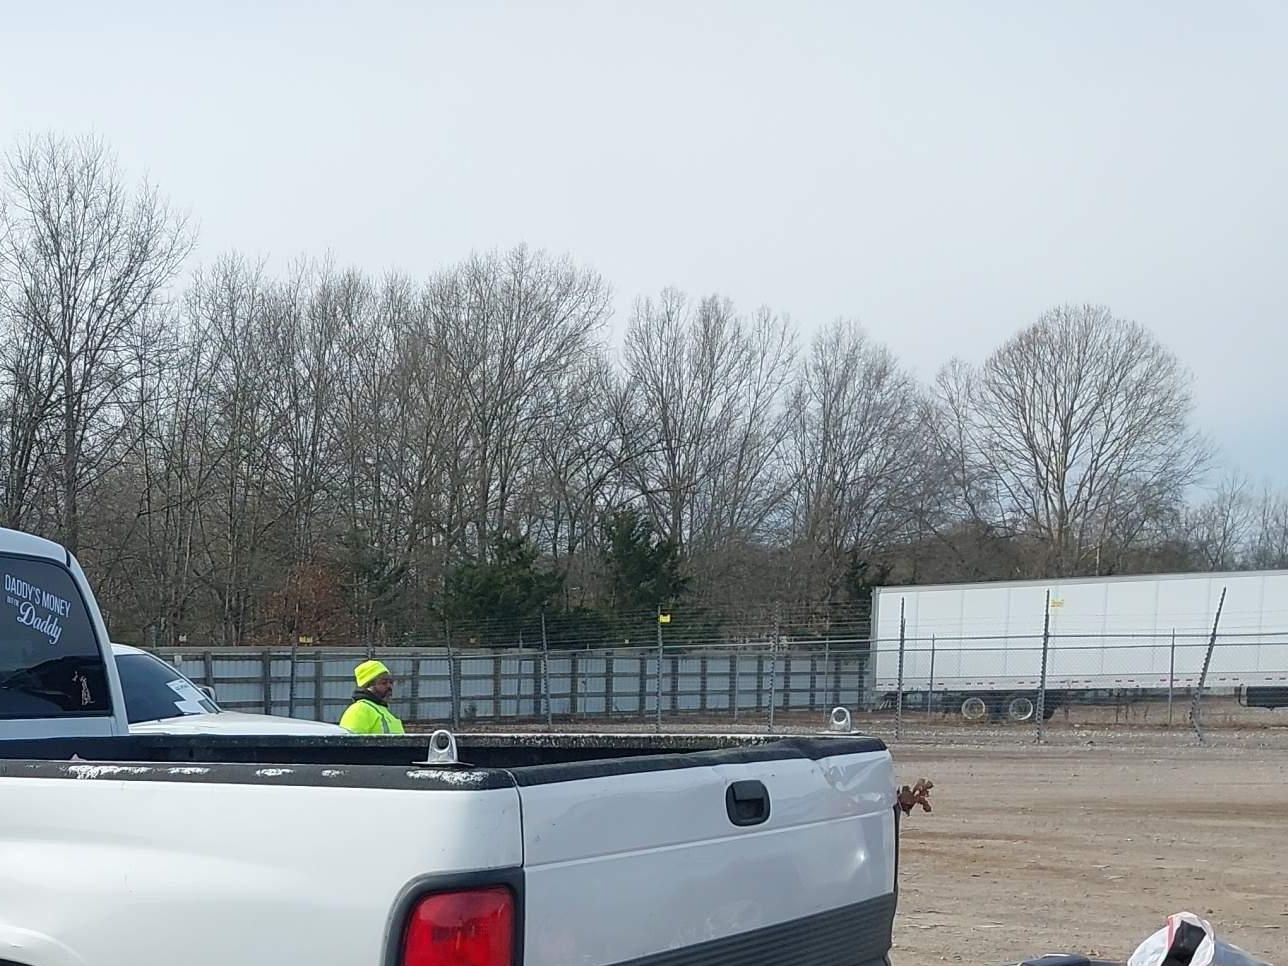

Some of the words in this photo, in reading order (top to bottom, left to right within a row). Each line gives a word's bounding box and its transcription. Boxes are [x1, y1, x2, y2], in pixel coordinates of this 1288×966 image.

[5, 574, 41, 605] DADDY'S
[41, 590, 71, 618] MONEY
[17, 601, 62, 645] Daddy
